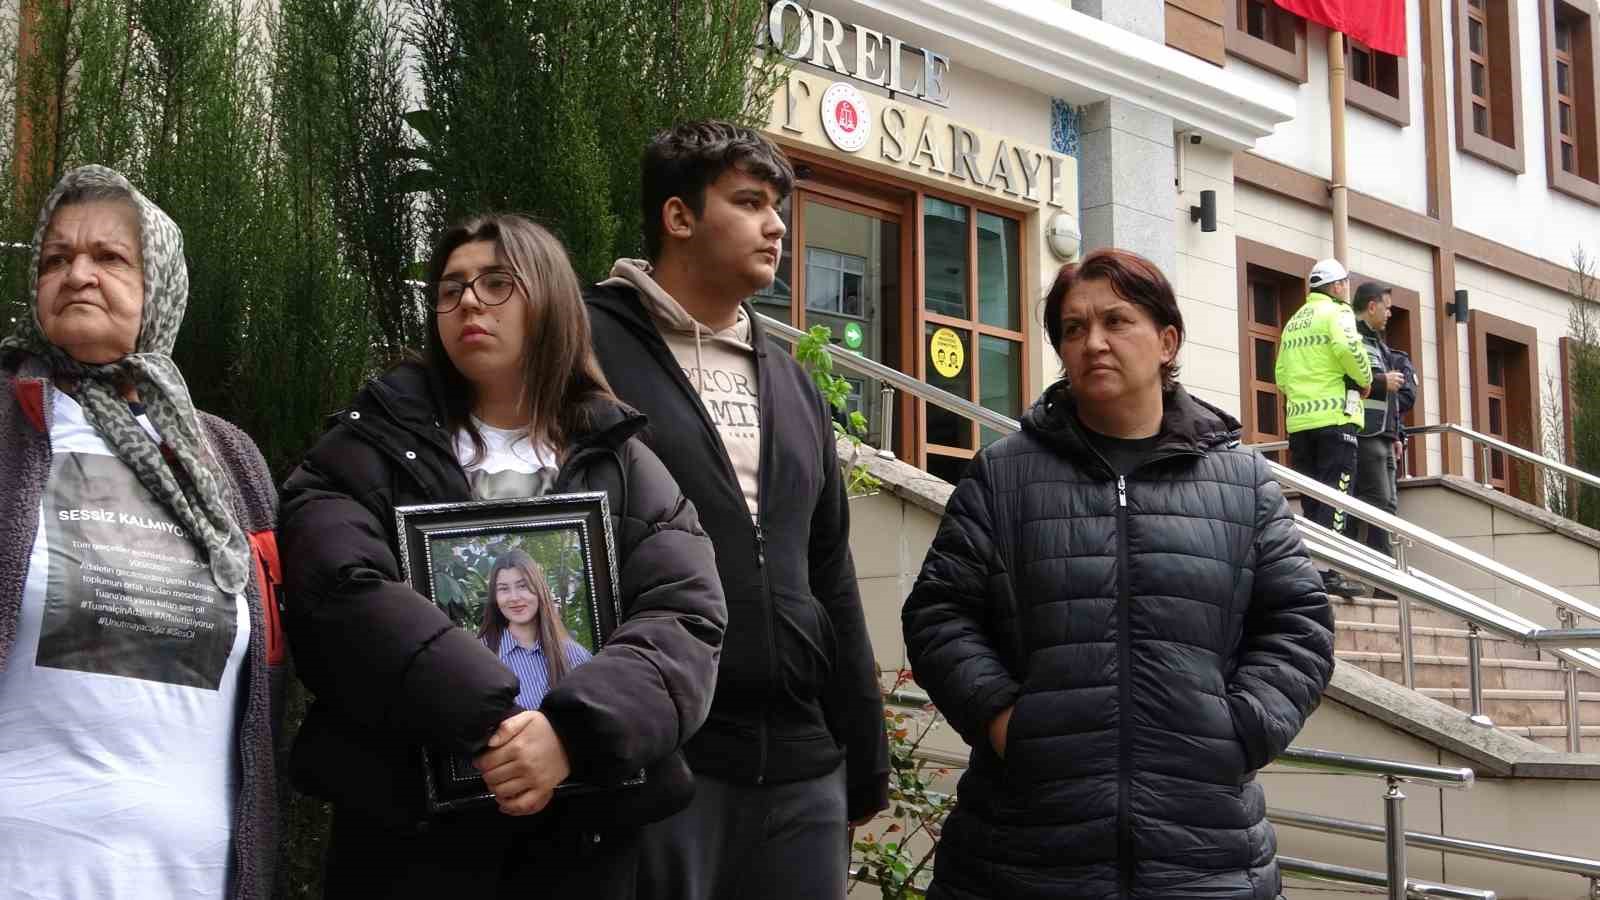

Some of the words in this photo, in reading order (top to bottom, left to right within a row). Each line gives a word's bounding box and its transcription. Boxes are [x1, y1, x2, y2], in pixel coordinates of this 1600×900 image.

[880, 105, 1066, 209] SARAYI
[58, 509, 116, 523] SESSİZ
[119, 513, 186, 537] KALMIYO
[82, 574, 123, 589] toplumun
[123, 581, 146, 593] ortak
